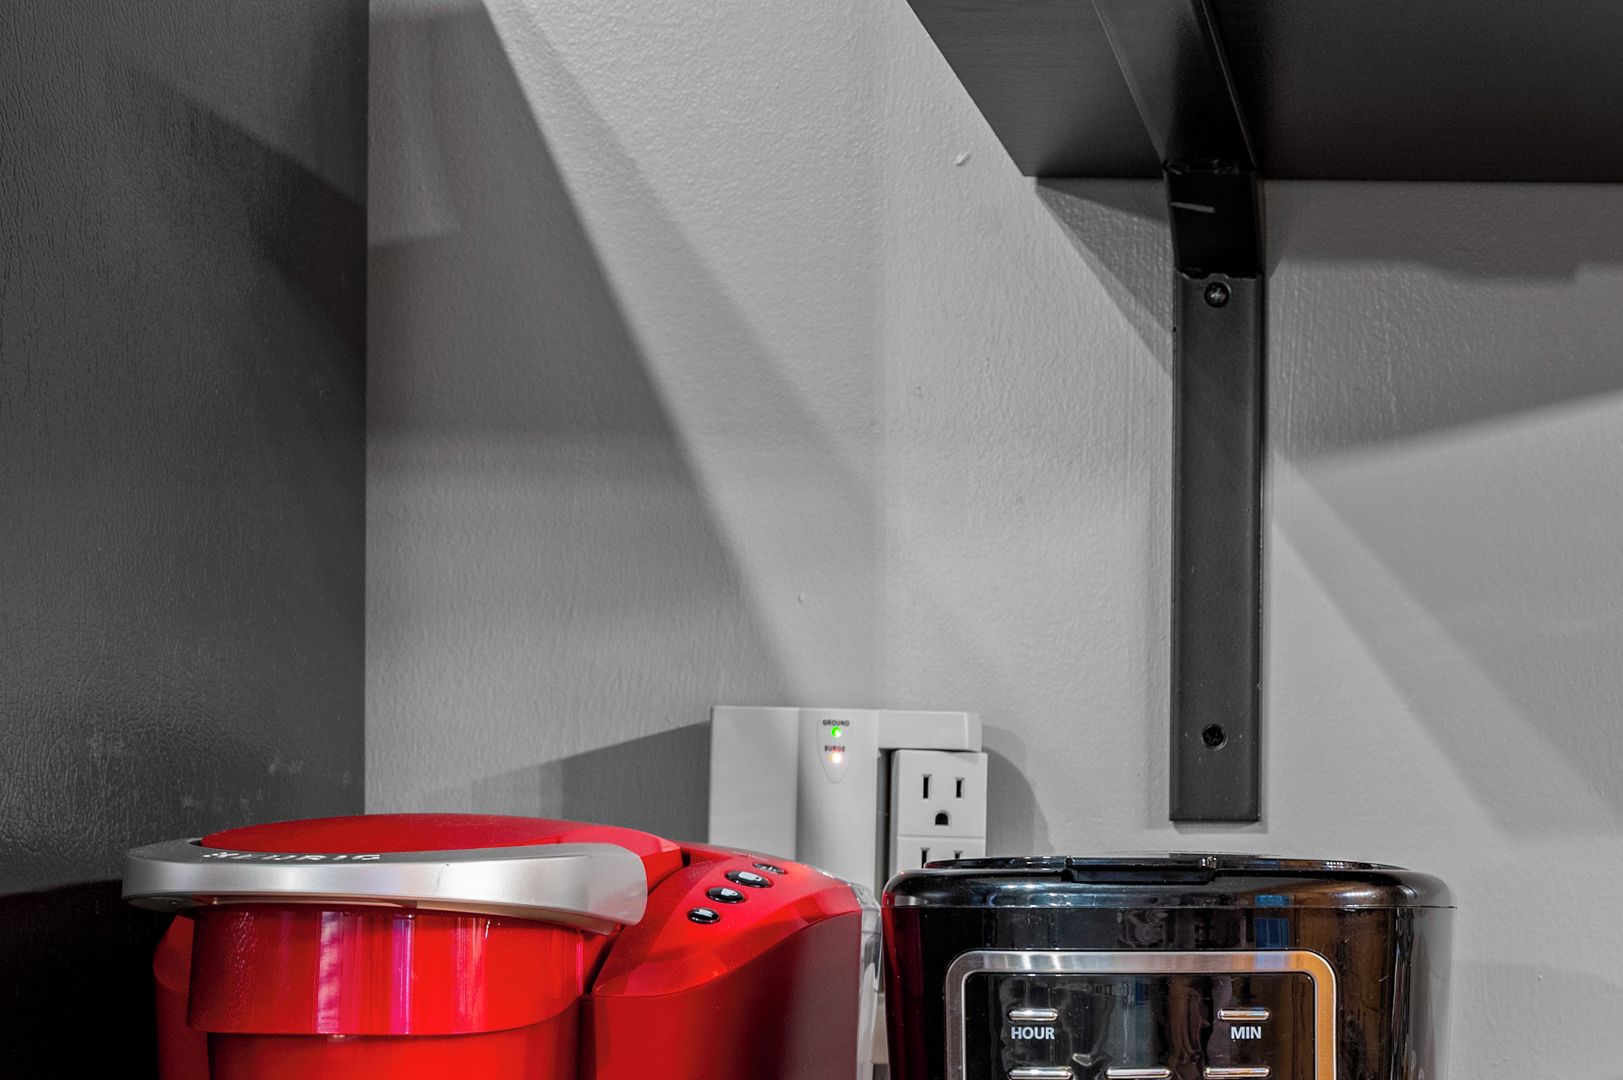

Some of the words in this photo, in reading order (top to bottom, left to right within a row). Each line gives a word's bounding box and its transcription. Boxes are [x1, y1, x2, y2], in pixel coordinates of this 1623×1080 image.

[822, 719, 850, 727] GROUND
[1011, 1027, 1056, 1040] HOUR
[1230, 1026, 1262, 1040] MIN
